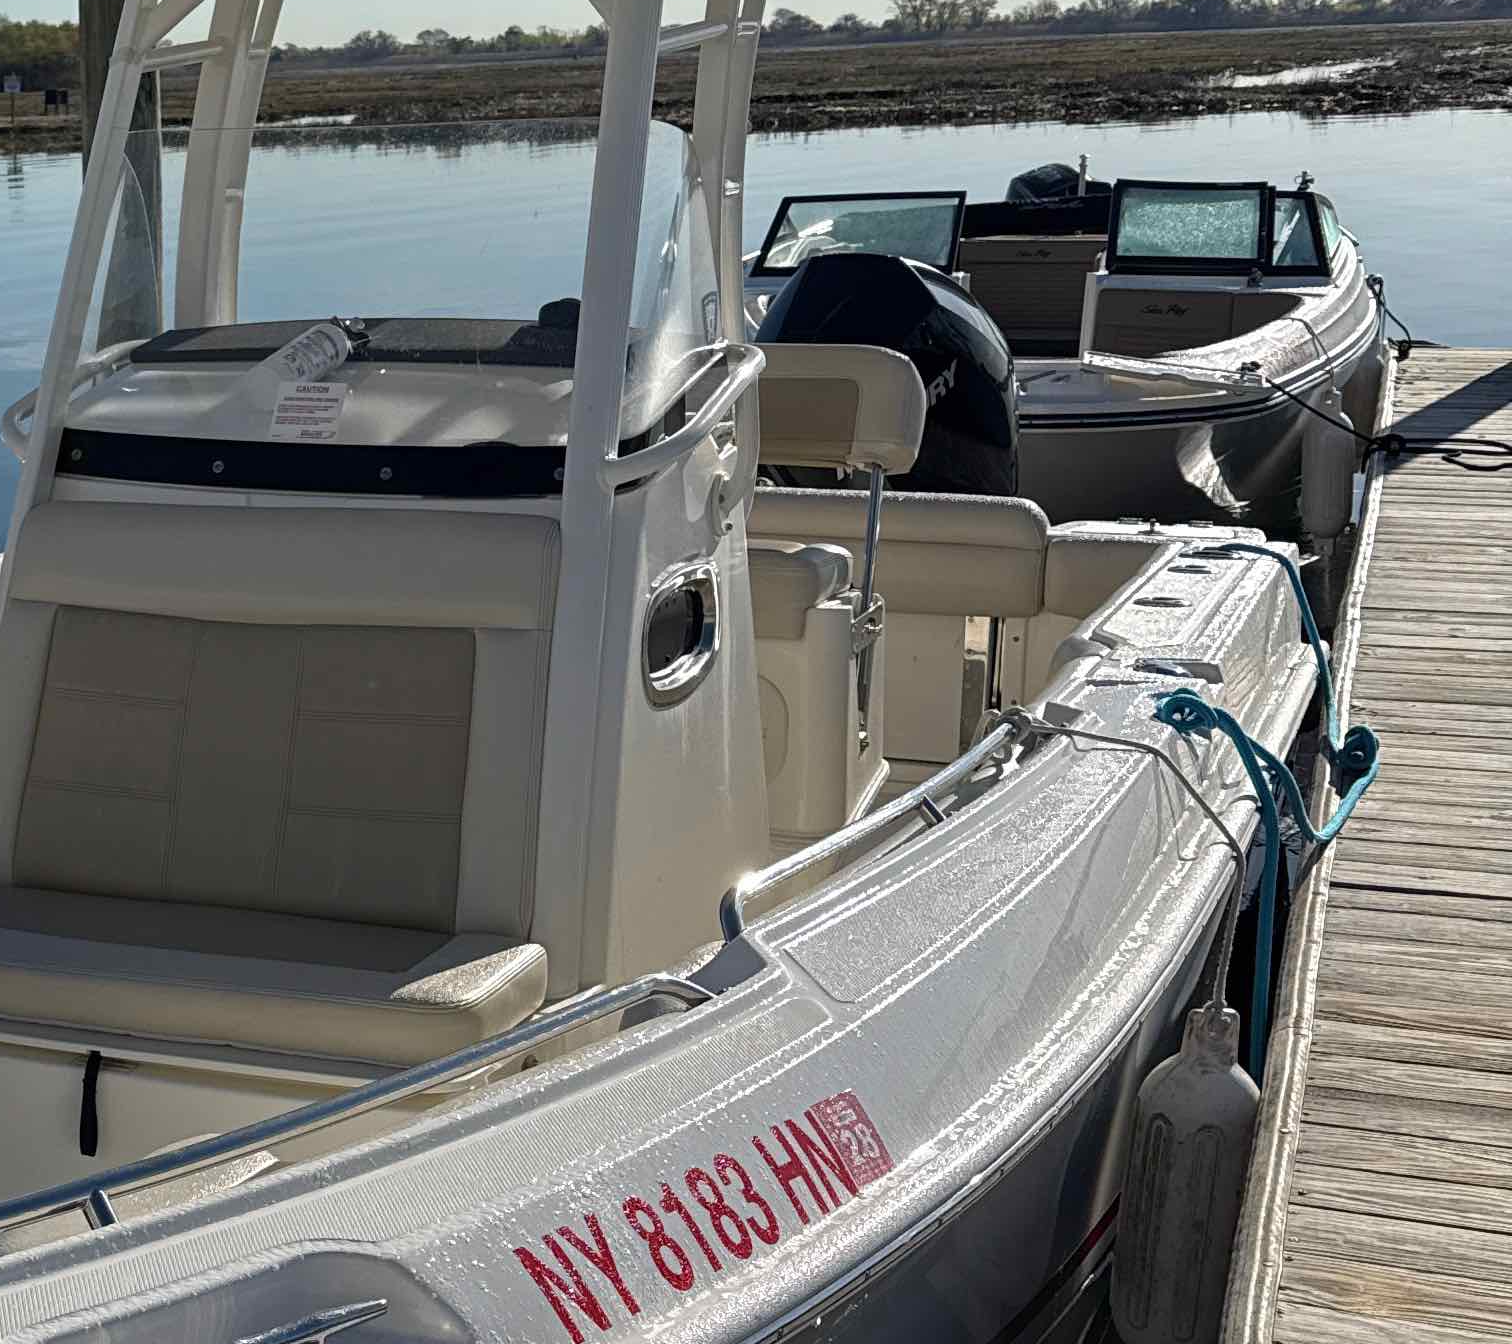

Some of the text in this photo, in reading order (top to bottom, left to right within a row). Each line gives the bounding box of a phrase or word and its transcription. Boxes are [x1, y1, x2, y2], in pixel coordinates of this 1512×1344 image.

[296, 385, 330, 394] CAUTION
[513, 1109, 861, 1344] NY 8183 HN
